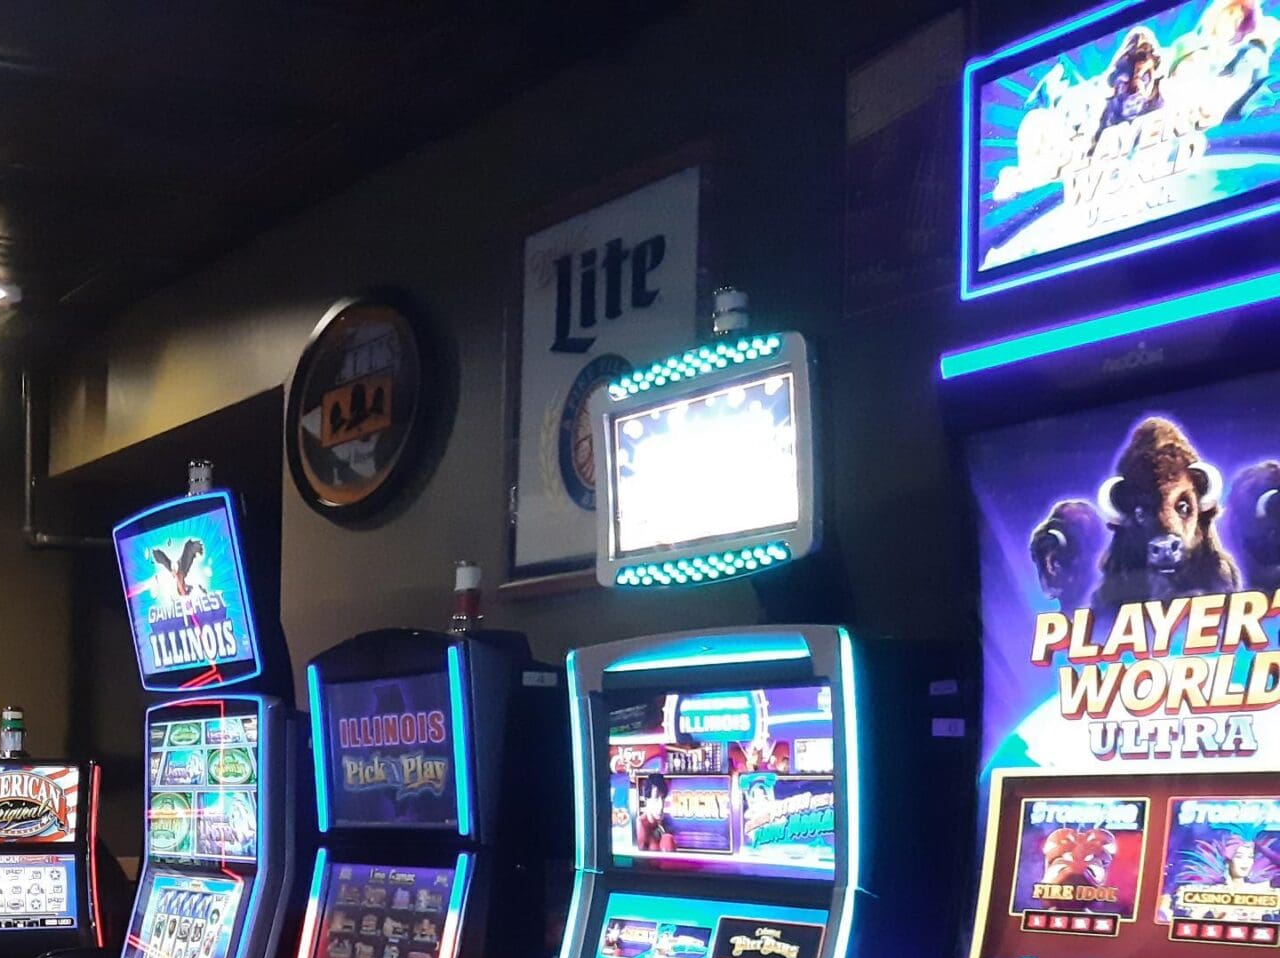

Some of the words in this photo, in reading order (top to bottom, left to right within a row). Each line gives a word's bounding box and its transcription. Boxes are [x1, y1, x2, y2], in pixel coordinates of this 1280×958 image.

[549, 234, 665, 354] Lite
[150, 619, 237, 669] ILLINOIS
[1031, 589, 1280, 666] PLAYER
[1059, 652, 1280, 719] WORLD
[339, 710, 446, 748] ILLINOIS
[1088, 714, 1259, 761] ULTRA
[345, 756, 387, 785] Pick
[402, 754, 446, 790] Play
[1032, 884, 1074, 900] FIRE
[1184, 891, 1232, 904] CASINO
[1233, 893, 1279, 908] RICHES
